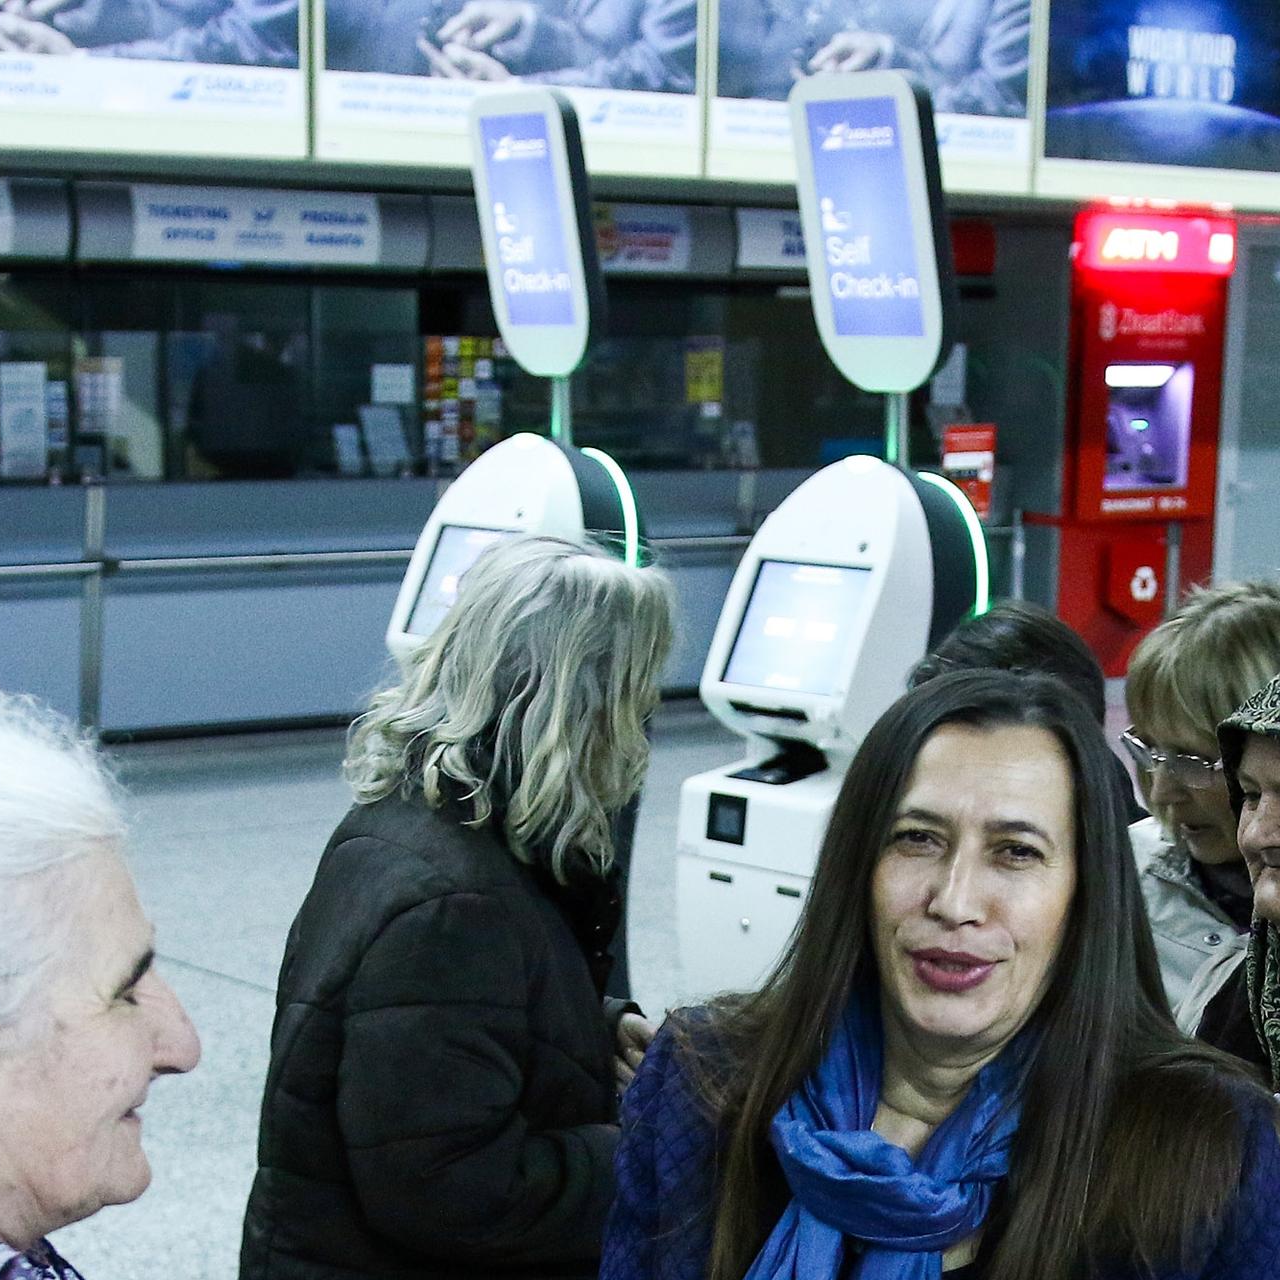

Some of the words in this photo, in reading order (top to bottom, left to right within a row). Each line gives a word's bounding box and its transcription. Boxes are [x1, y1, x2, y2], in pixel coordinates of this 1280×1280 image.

[825, 235, 871, 266] Self
[1101, 227, 1179, 262] ATM
[830, 271, 919, 299] Check-in
